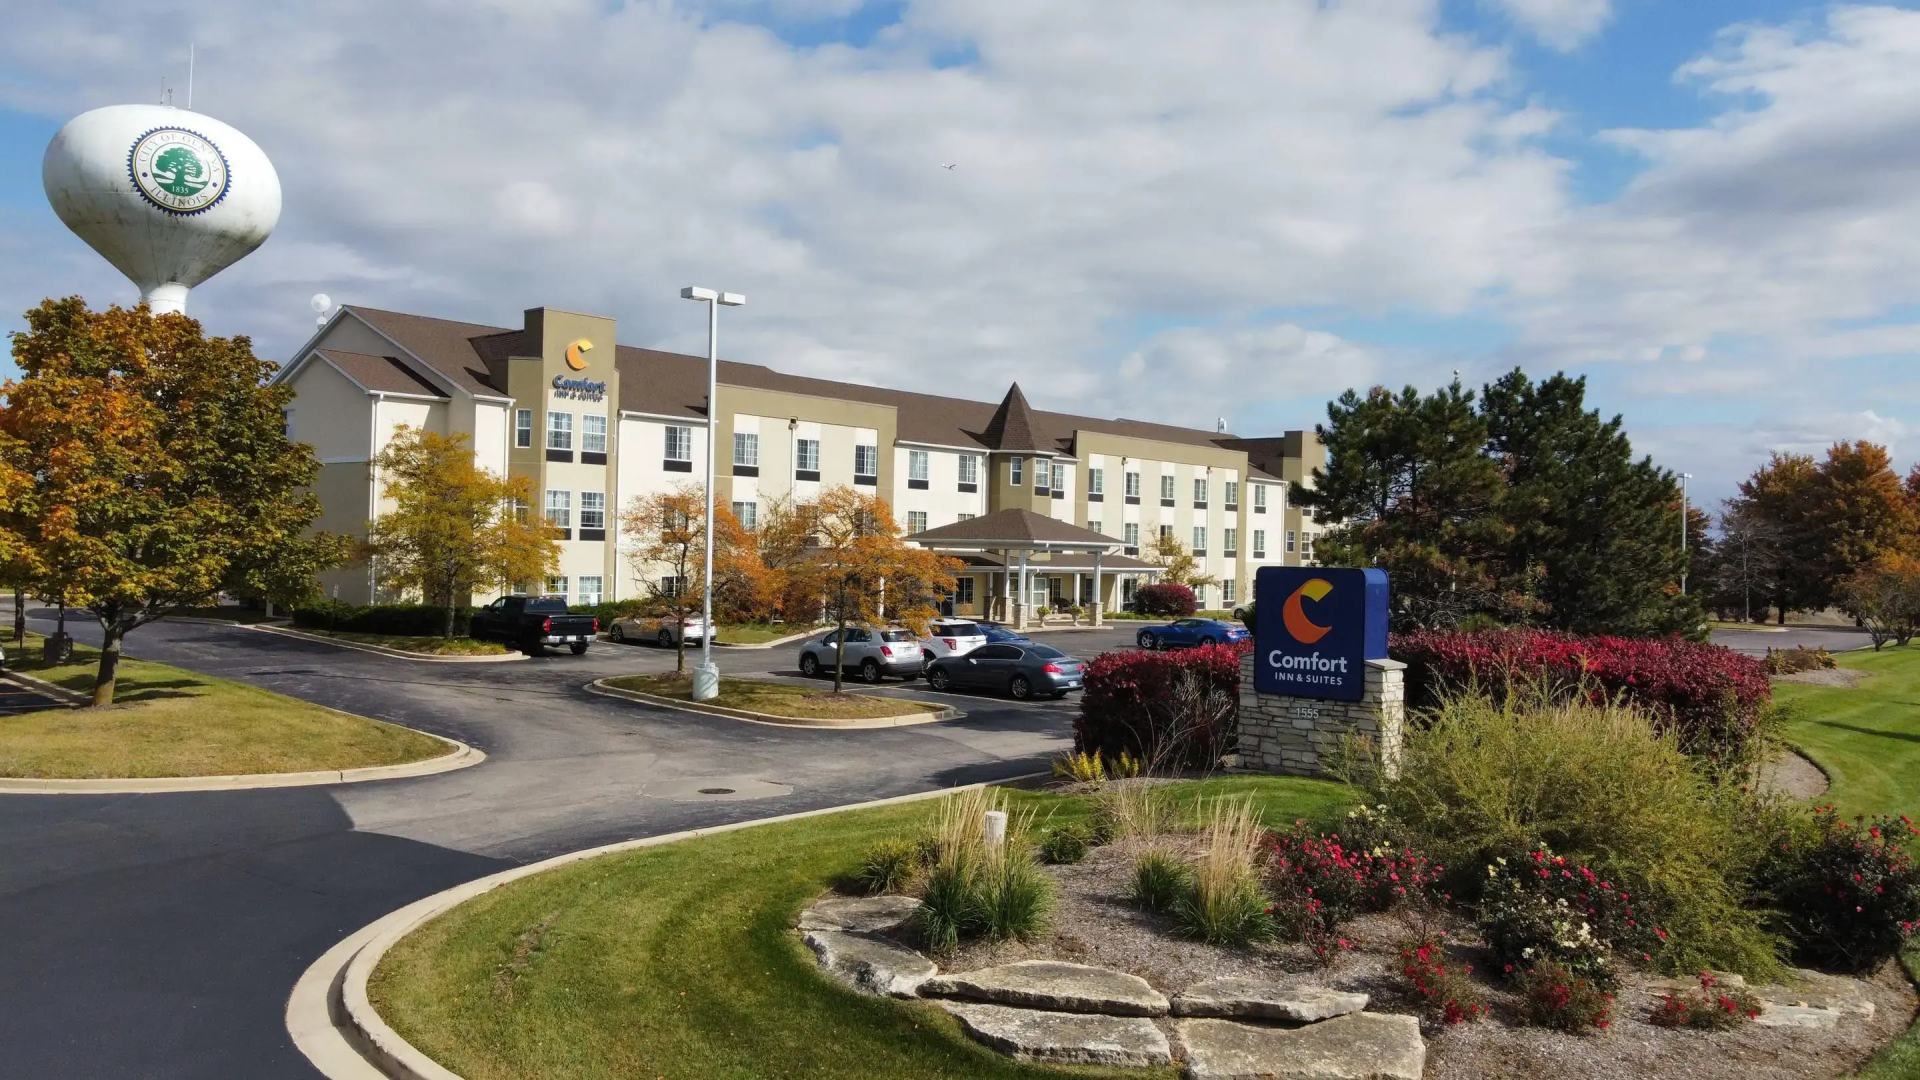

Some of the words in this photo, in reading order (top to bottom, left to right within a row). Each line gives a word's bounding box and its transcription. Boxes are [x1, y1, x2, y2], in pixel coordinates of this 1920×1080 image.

[139, 138, 159, 163] CITY
[160, 133, 177, 142] OF
[151, 186, 208, 207] ILLINOIS
[171, 185, 190, 194] 1835
[551, 374, 607, 395] Comfort
[1269, 649, 1348, 673] Comfort
[1274, 671, 1294, 681] INN
[1296, 673, 1304, 682] &
[1306, 674, 1343, 686] SUITES
[1295, 707, 1319, 719] 1555
